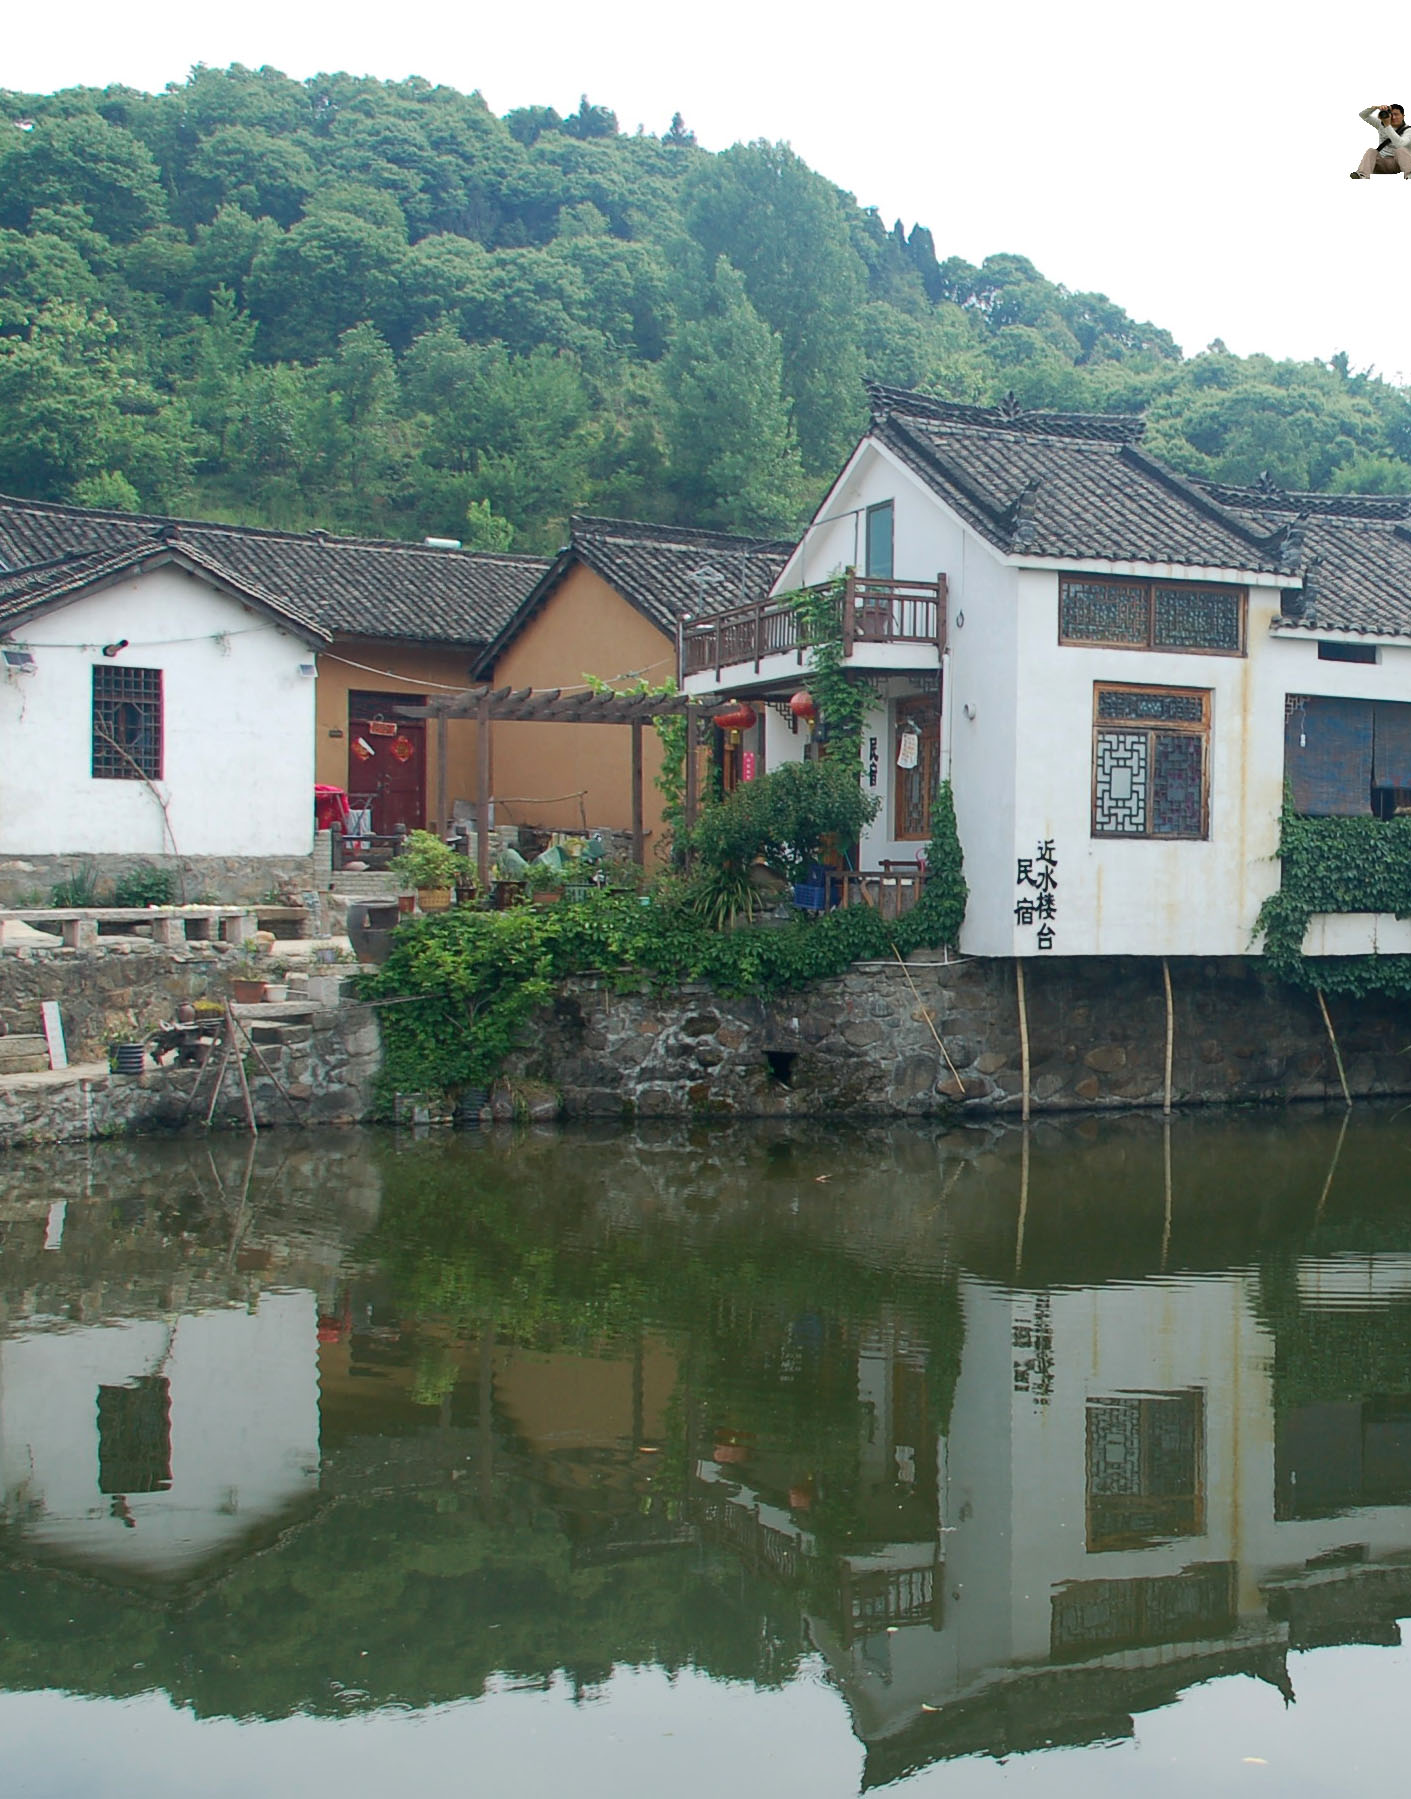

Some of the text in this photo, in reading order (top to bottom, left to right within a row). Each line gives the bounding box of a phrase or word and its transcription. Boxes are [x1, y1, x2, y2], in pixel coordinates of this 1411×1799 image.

[1014, 858, 1037, 926] 民宿
[1036, 838, 1058, 950] 近水楼台
